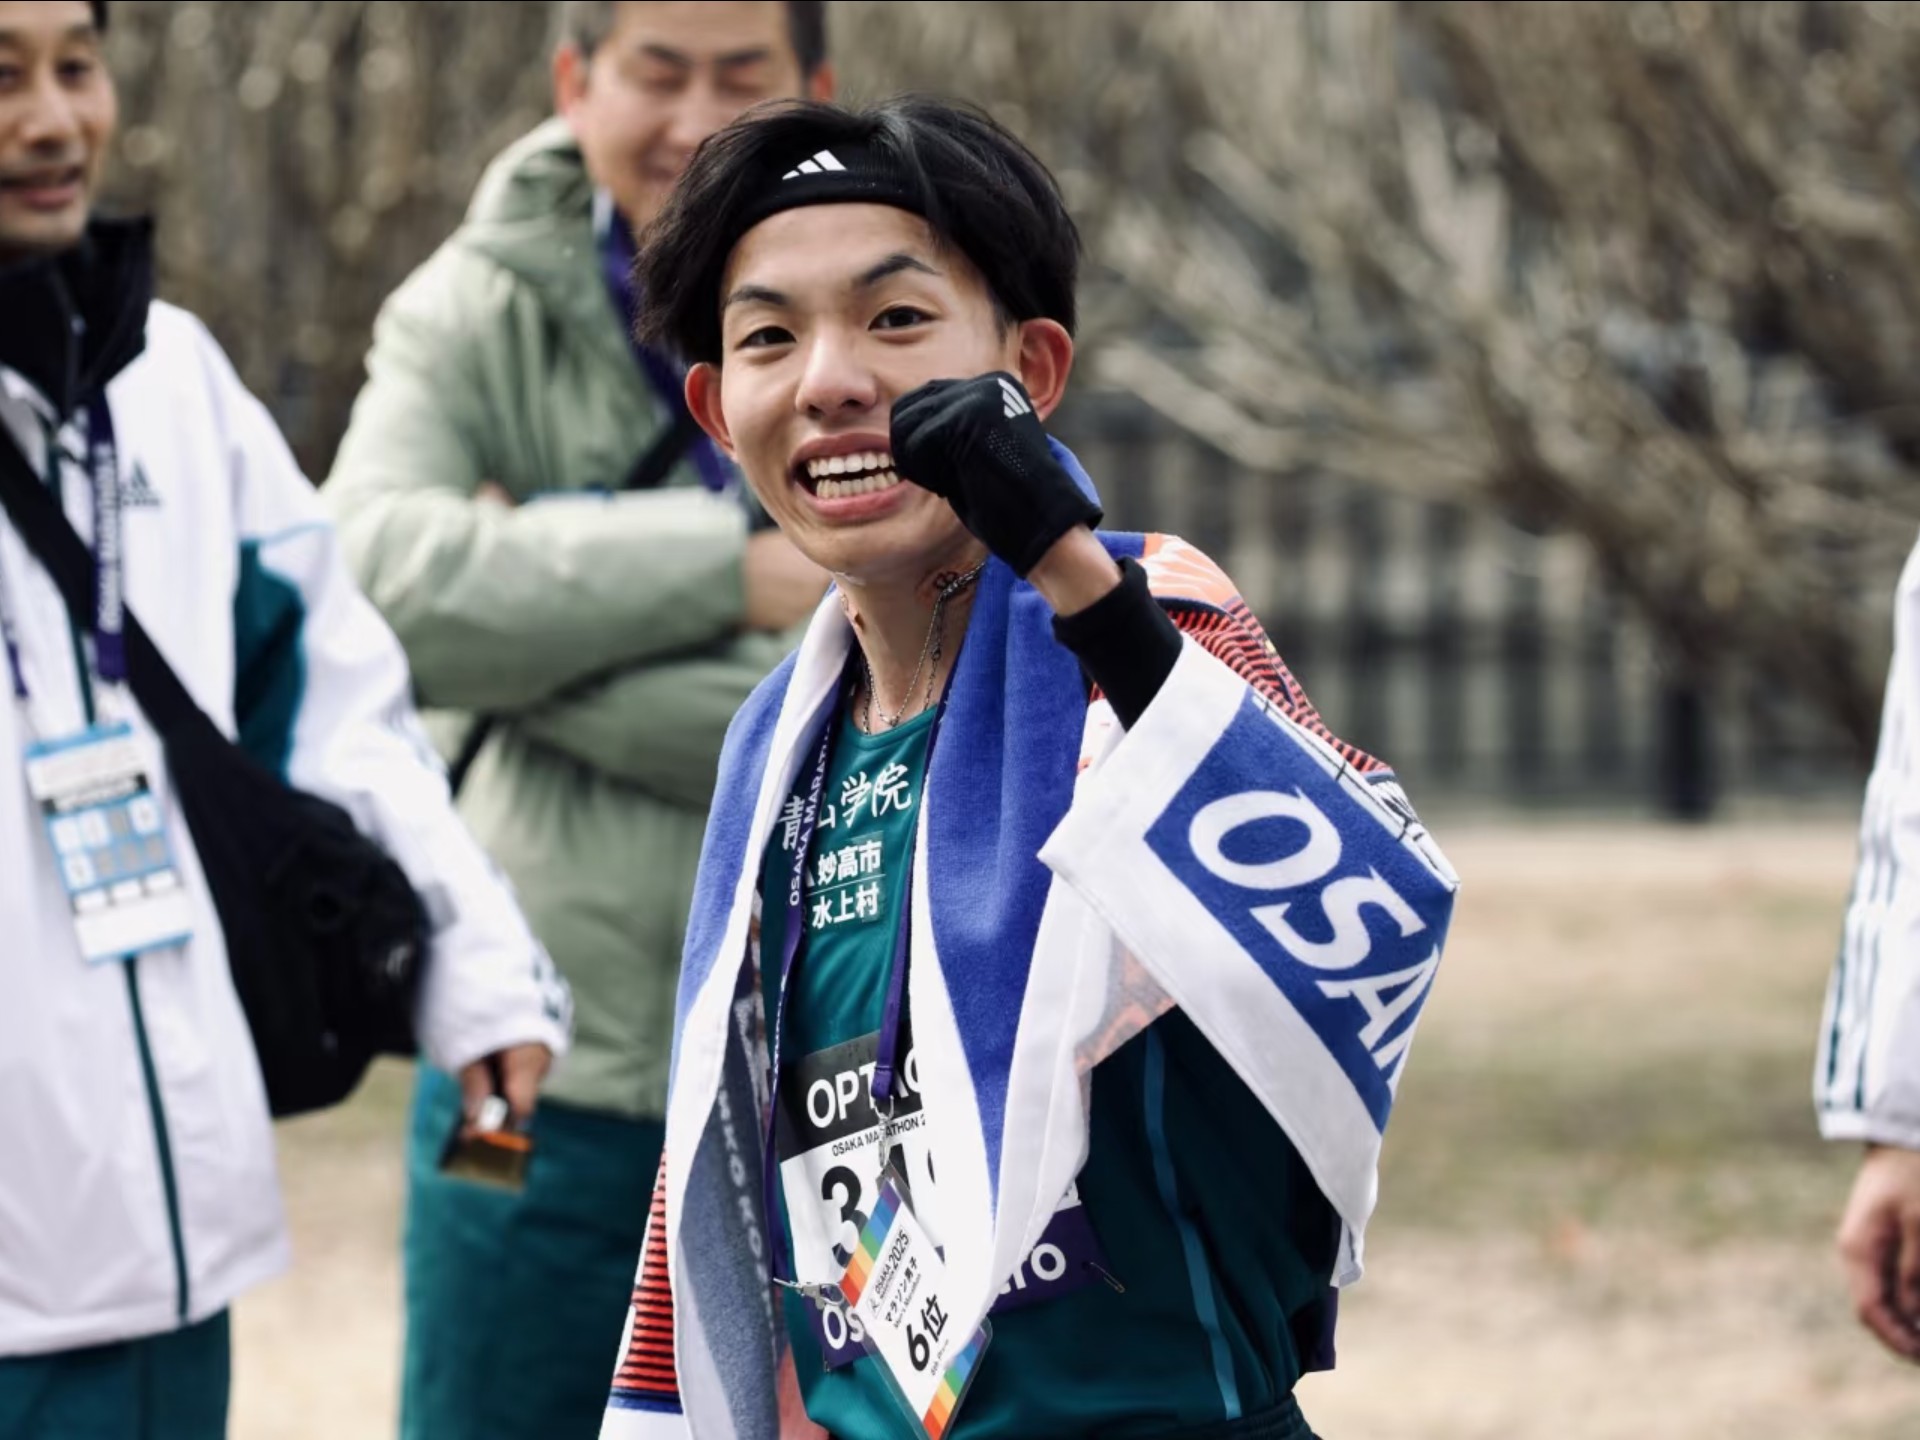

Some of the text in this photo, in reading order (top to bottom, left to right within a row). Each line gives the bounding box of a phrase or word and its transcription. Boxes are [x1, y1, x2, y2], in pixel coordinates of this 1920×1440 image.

[789, 827, 812, 907] OSAKA
[818, 840, 883, 887] 妙高市
[811, 882, 880, 930] 水上村
[831, 1135, 865, 1157] OSAKA
[865, 1116, 919, 1145] MAATHON
[888, 1229, 909, 1270] 2025
[906, 1294, 948, 1372] 6位
